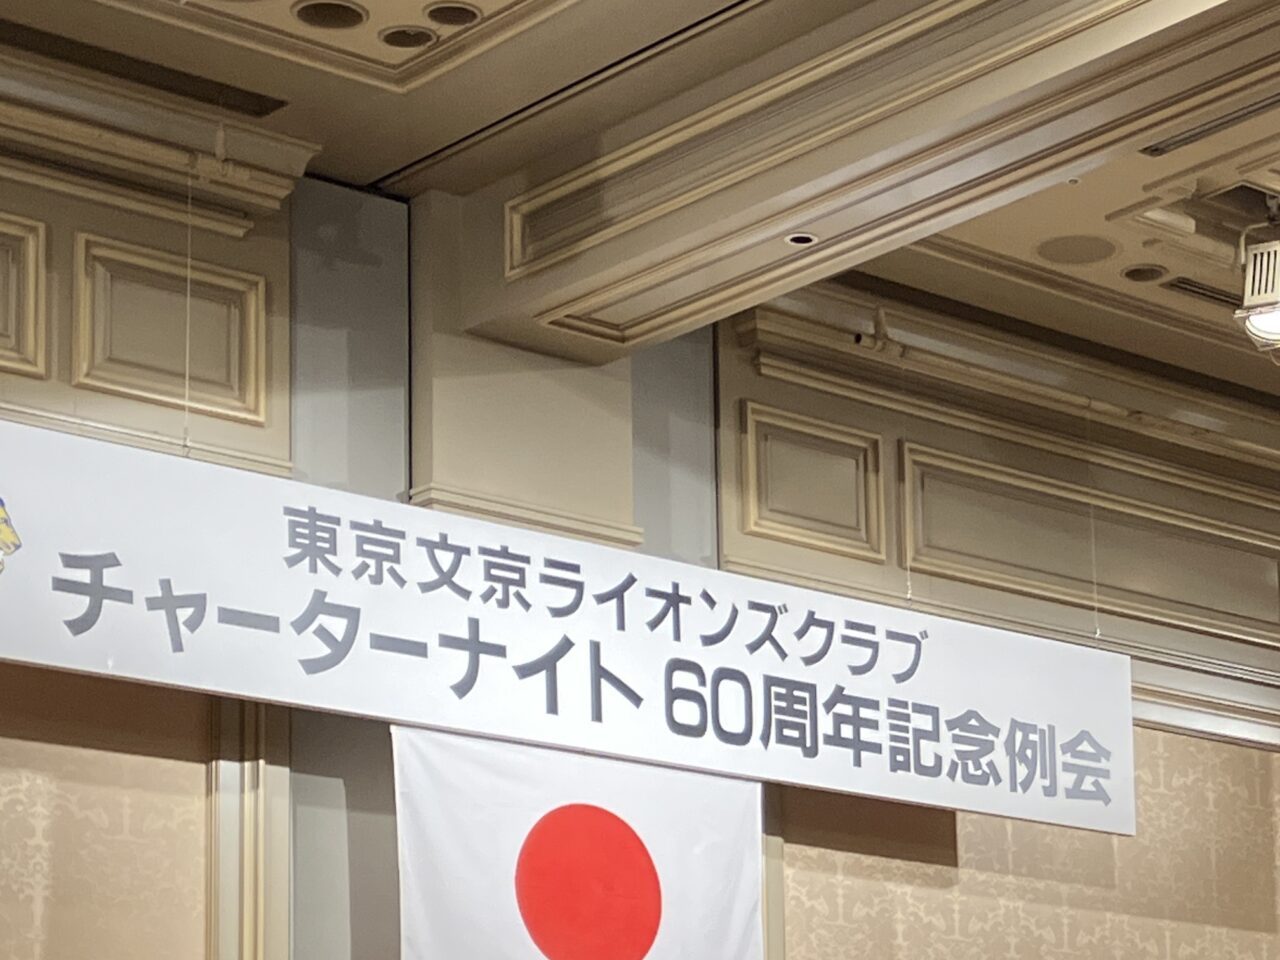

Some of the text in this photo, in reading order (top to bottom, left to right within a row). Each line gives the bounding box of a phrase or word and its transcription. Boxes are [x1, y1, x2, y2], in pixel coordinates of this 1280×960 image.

[283, 506, 929, 684] 東京文京ライオンズクラブ
